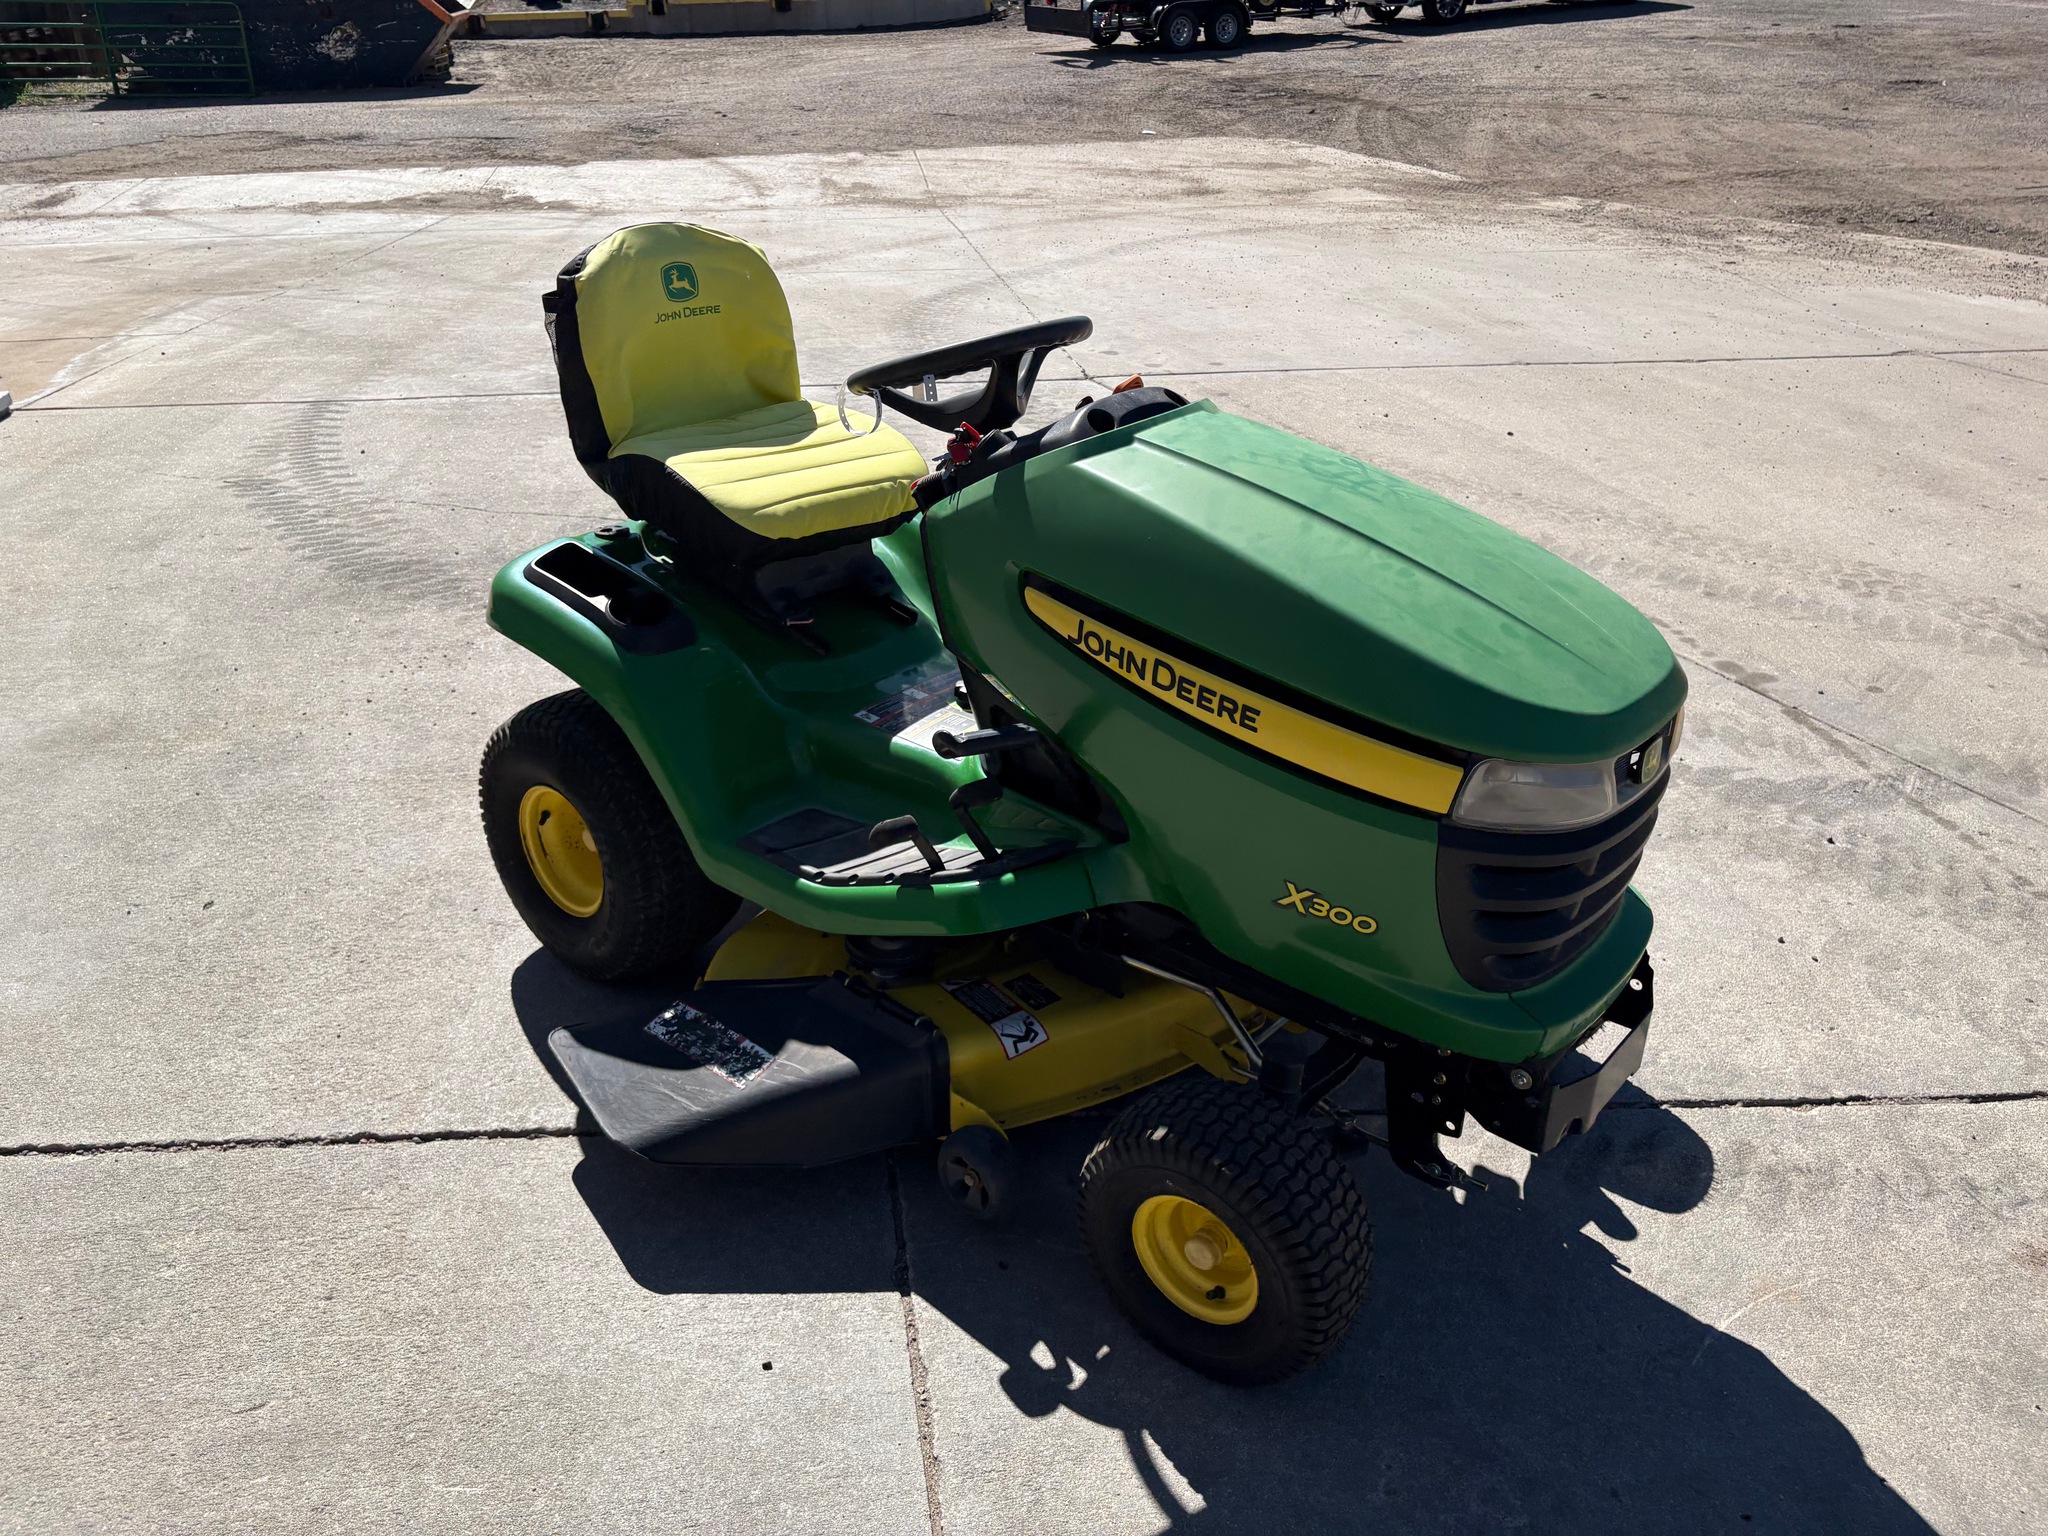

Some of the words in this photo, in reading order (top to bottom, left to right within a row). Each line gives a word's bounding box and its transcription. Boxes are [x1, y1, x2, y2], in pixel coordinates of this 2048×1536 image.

[654, 309, 682, 324] JOHN
[683, 304, 721, 318] DEERE
[1067, 618, 1148, 682] JOHN
[1151, 657, 1262, 734] DEERE
[1274, 879, 1379, 935] X300
